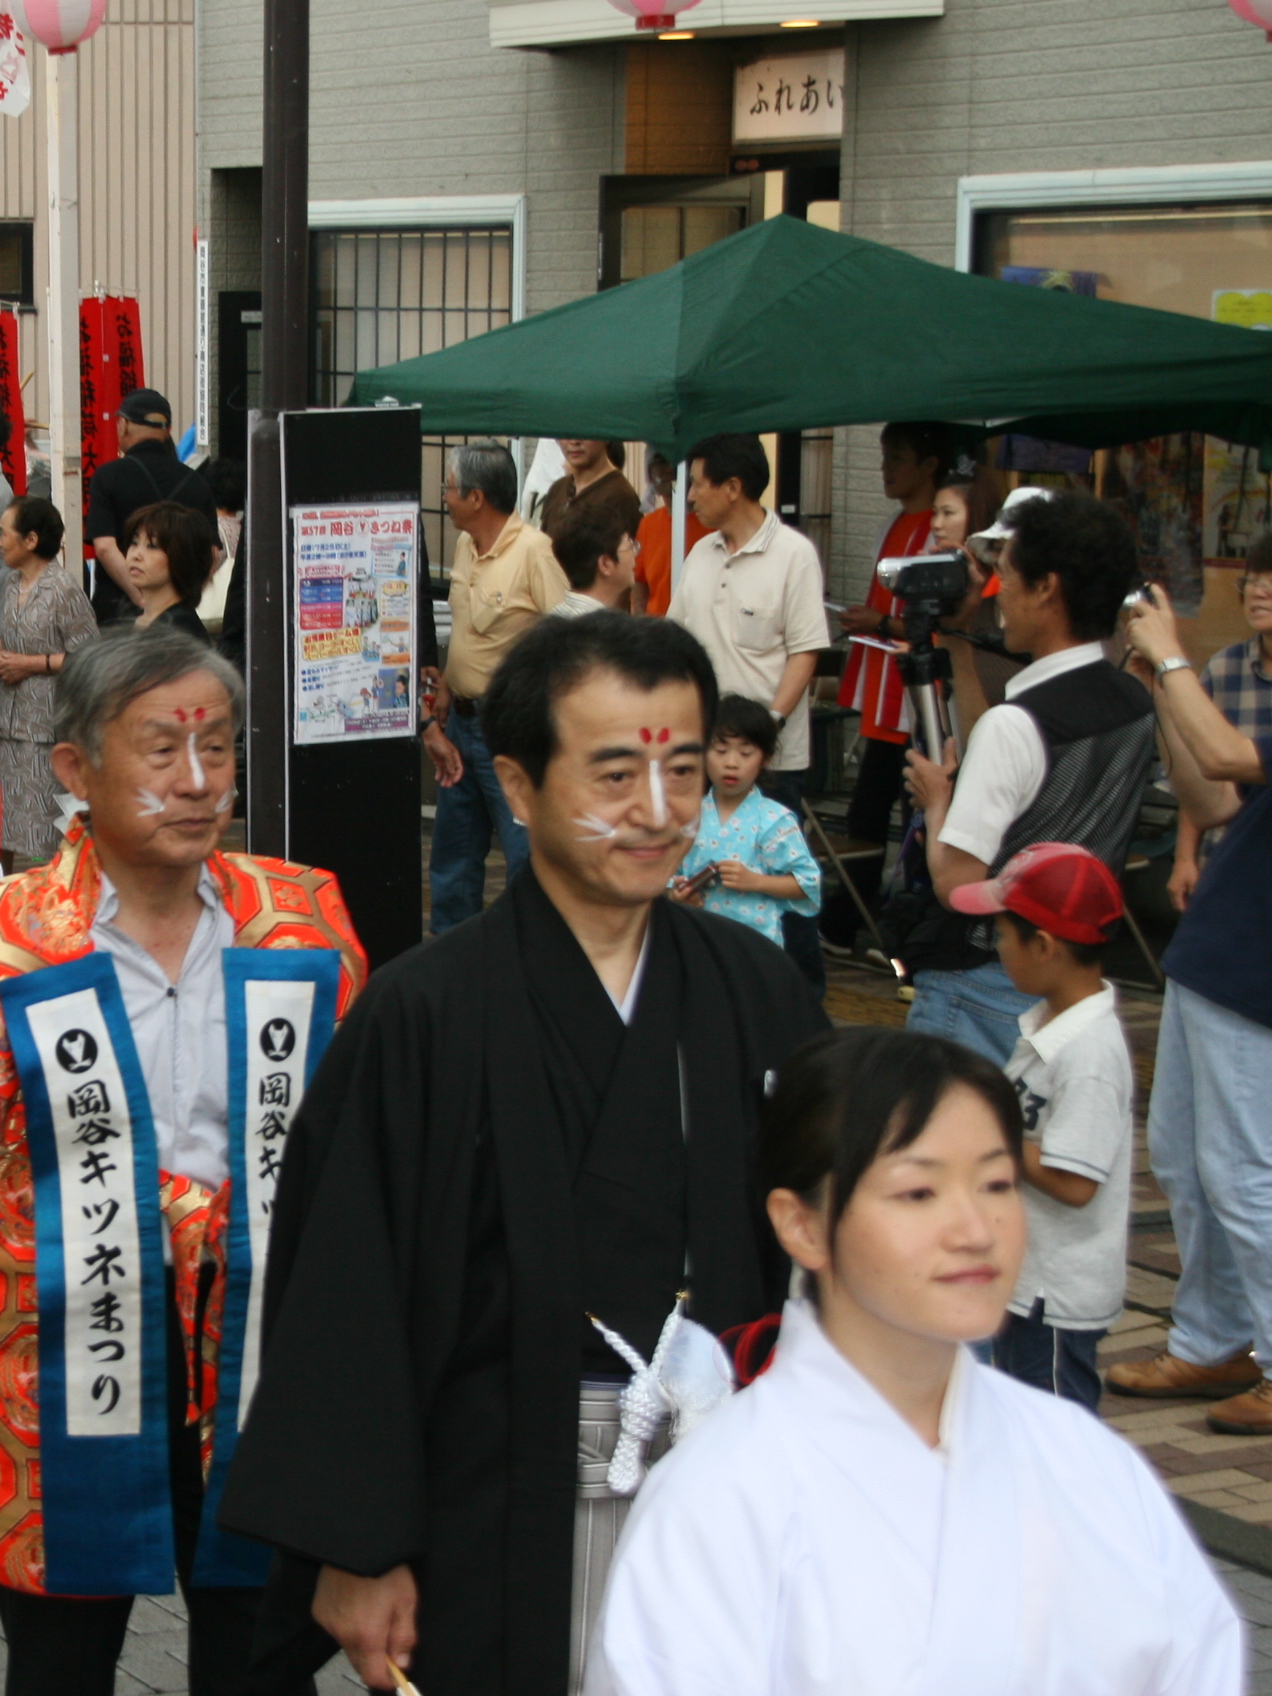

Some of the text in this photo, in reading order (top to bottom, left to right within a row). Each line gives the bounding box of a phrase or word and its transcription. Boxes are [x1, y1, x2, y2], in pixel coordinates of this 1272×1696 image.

[67, 1078, 126, 1415] 岡谷キツネまつり
